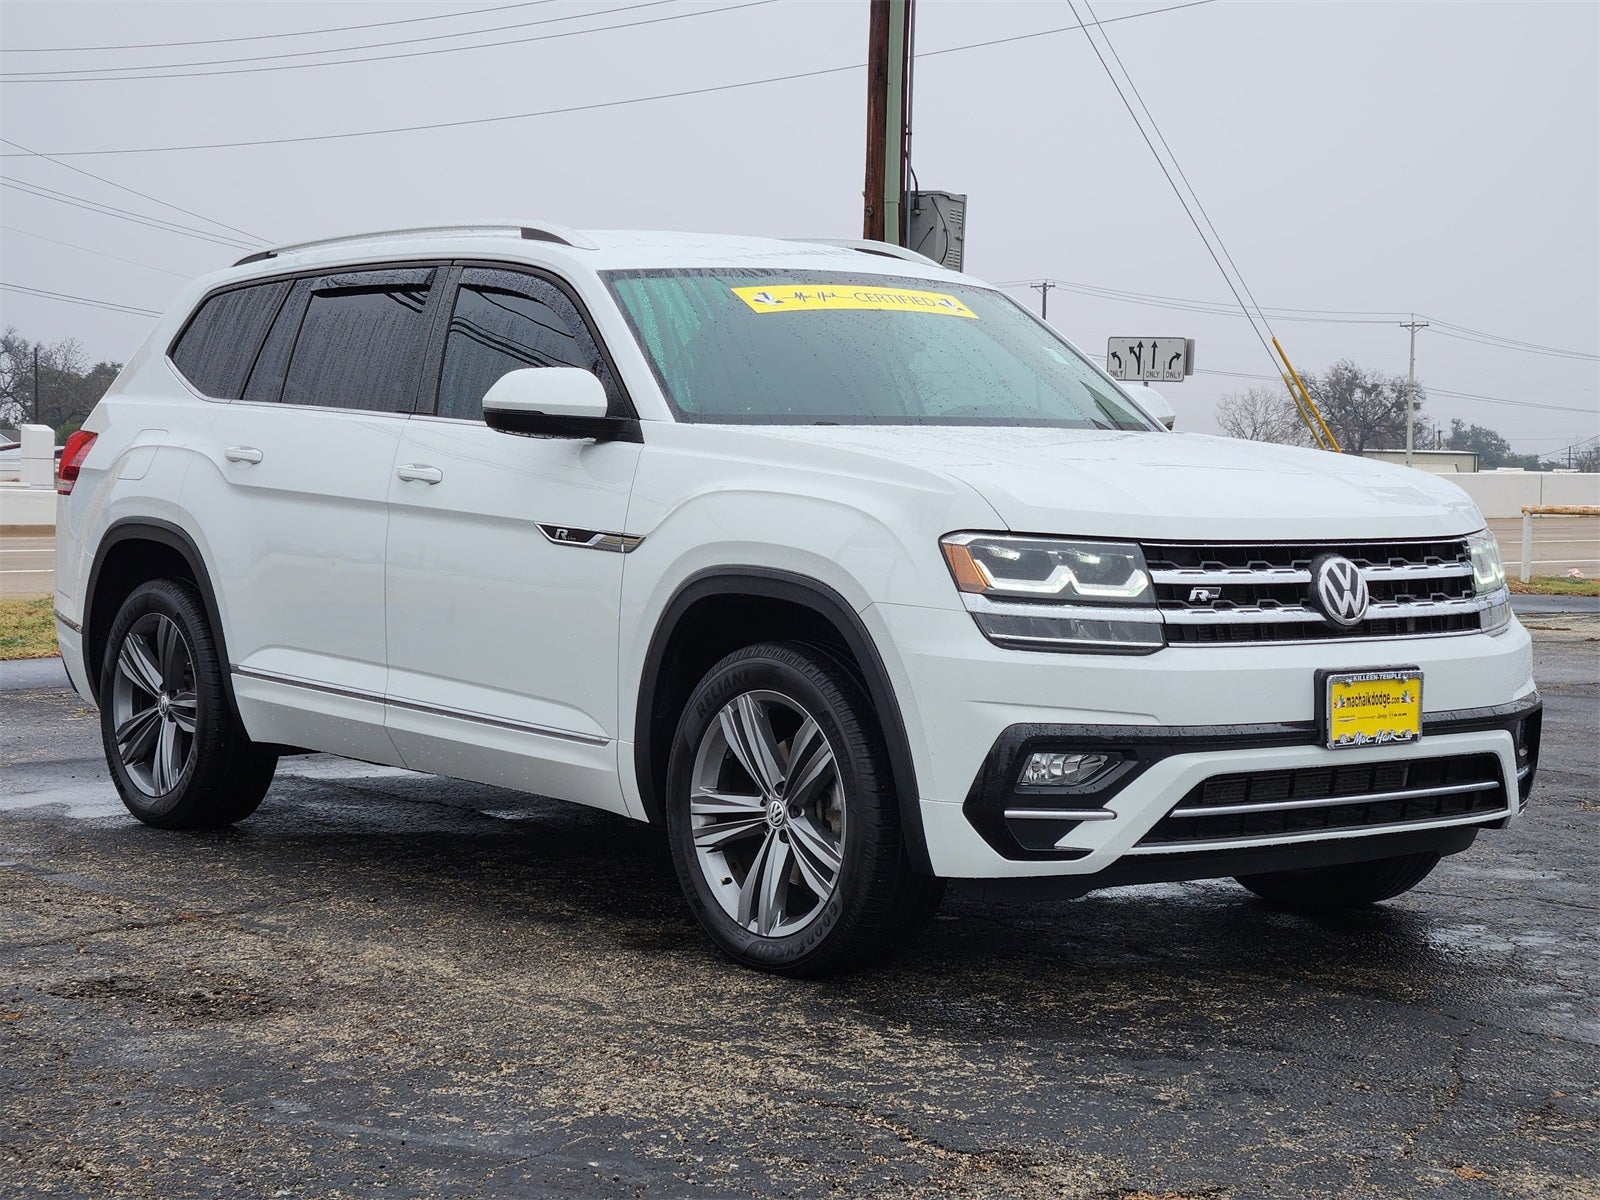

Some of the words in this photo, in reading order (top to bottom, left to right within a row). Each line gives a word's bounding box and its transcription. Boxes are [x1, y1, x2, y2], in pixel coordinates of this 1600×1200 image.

[853, 292, 937, 307] CERTIFIED
[1108, 370, 1124, 378] ONLY
[1146, 370, 1160, 379] ONLY
[1165, 371, 1182, 379] ONLY
[1353, 672, 1402, 681] KILLEEN-TEMPLE
[696, 669, 753, 718] RELIANT
[1345, 690, 1401, 708] machaikdodge.com
[1353, 731, 1374, 746] Mac
